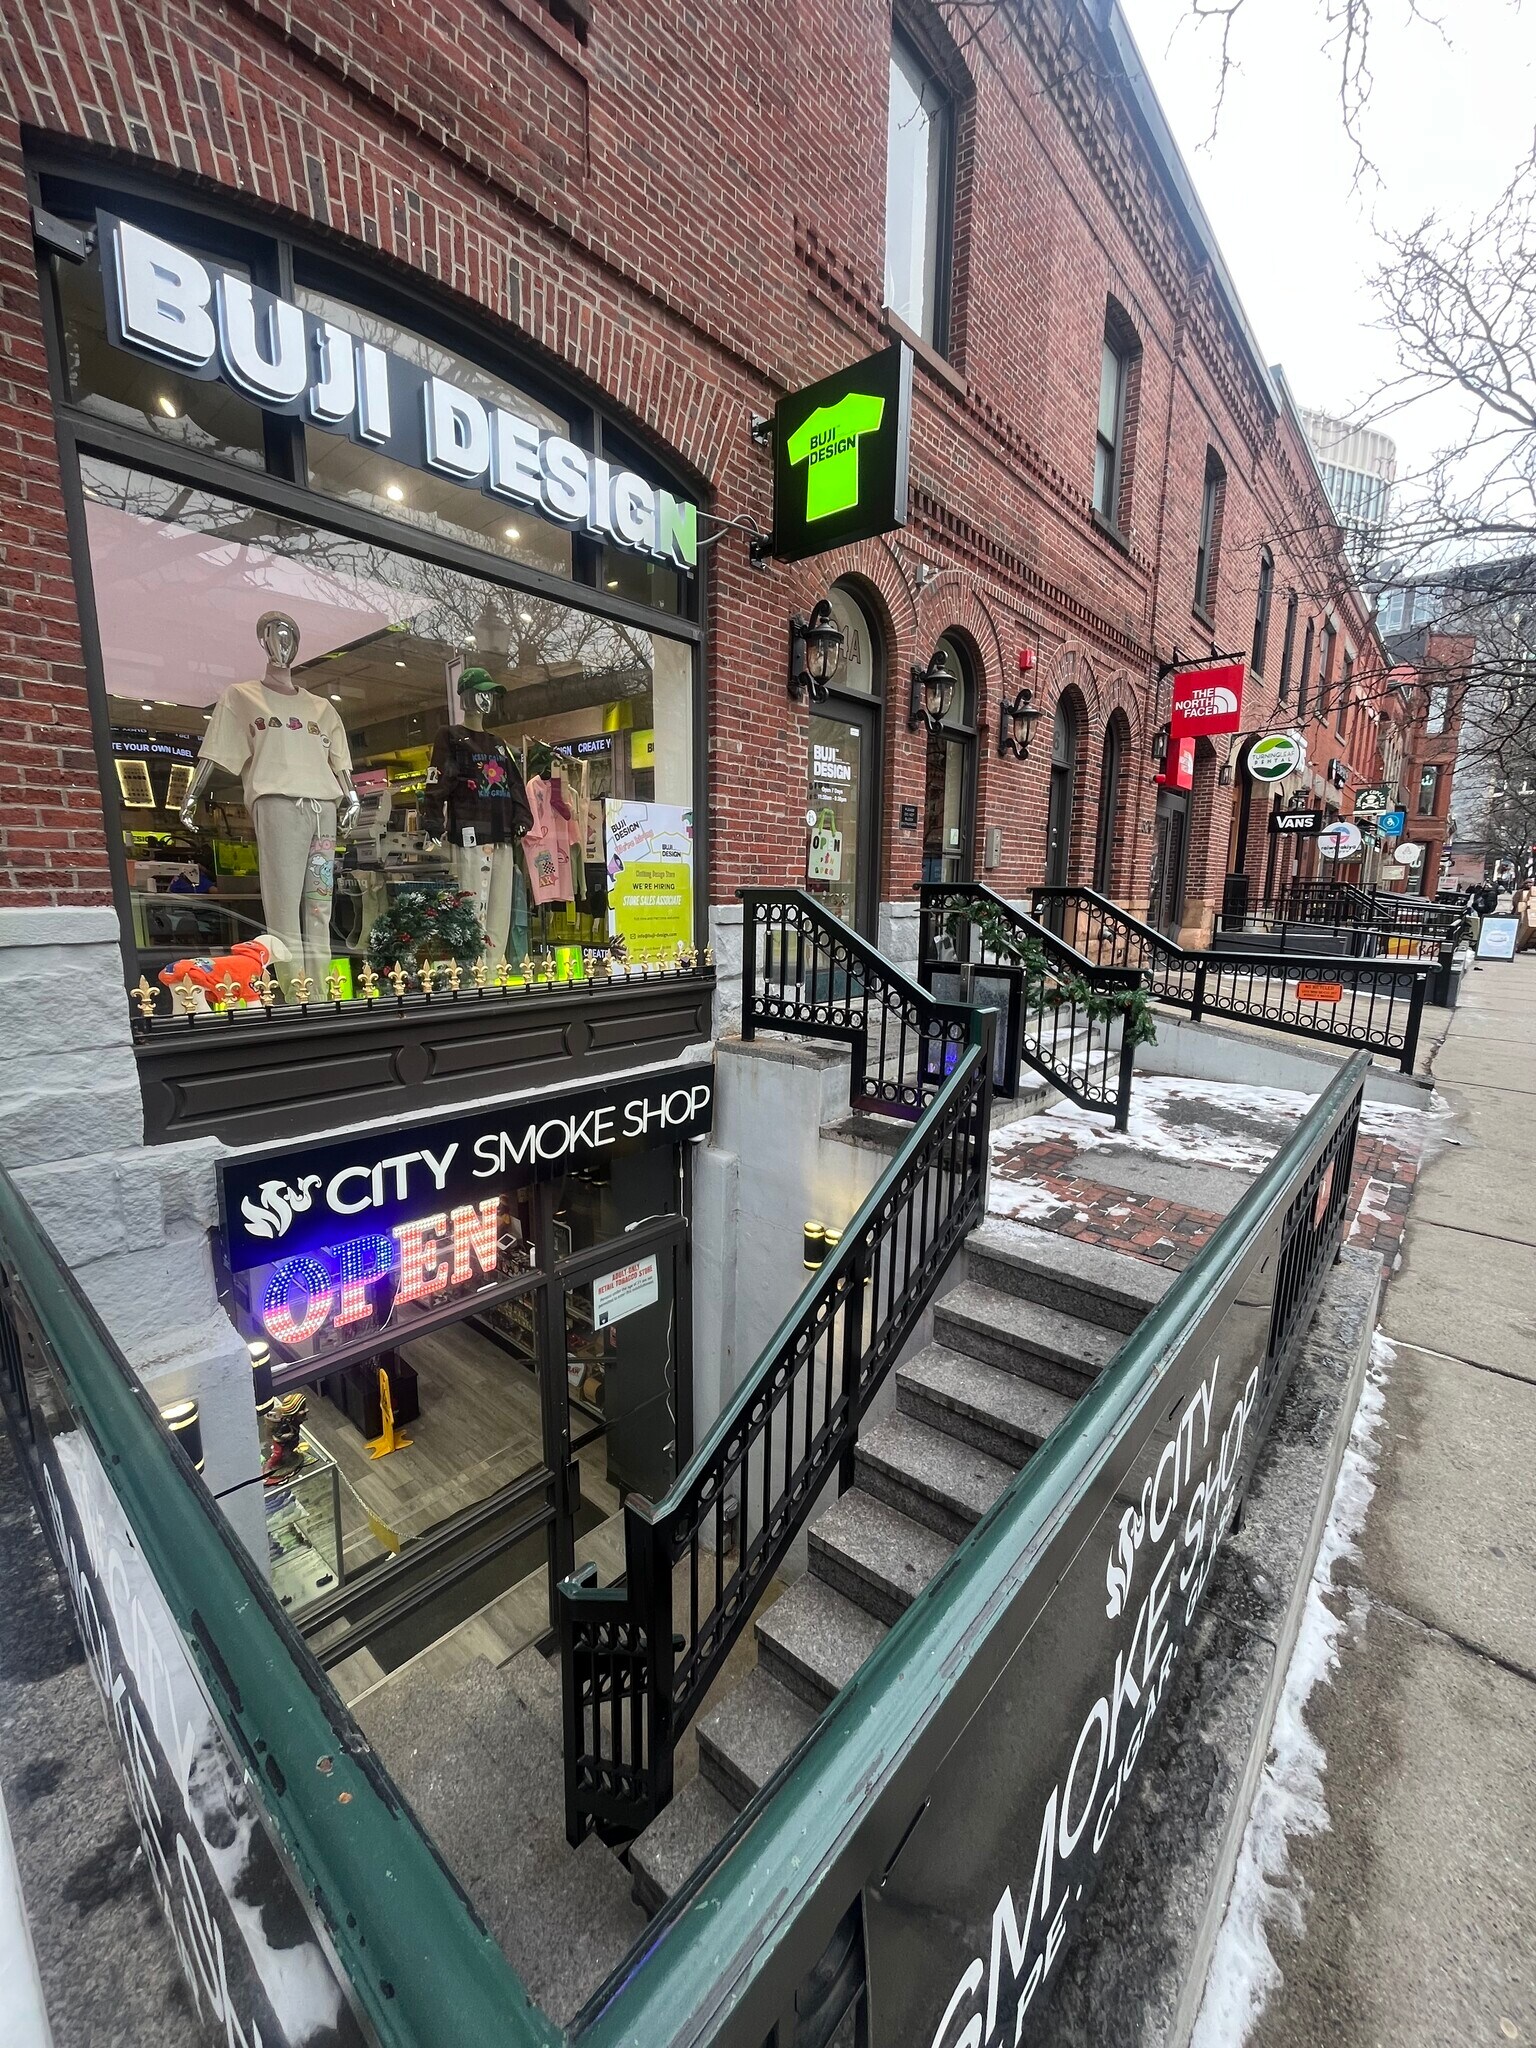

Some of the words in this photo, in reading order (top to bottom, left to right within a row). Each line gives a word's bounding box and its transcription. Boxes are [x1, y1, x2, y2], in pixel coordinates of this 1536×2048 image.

[113, 220, 392, 444] BUJI
[423, 375, 697, 571] DESIGN
[810, 427, 836, 450] BUJI
[810, 434, 856, 466] DESIGN
[1192, 687, 1214, 699] THE
[1175, 697, 1214, 711] NORTH
[1183, 705, 1214, 719] FACE
[123, 742, 150, 752] YOUR
[151, 743, 172, 754] OWN
[172, 748, 194, 758] LABEL
[578, 739, 605, 754] CREATE
[813, 744, 836, 762] BUJI
[1254, 757, 1292, 766] DENTAL
[813, 762, 851, 781] DESIGN
[611, 819, 627, 833] BUJI
[1276, 814, 1315, 829] VANS
[614, 821, 640, 842] DESIGN
[661, 850, 682, 858] DESIGN
[632, 882, 653, 890] WE'RE
[622, 895, 640, 906] STORE
[640, 895, 656, 906] SALES
[656, 895, 682, 906] ASSOCIATE
[326, 1142, 459, 1215] CITY
[472, 1106, 616, 1178] SMOKE
[622, 1084, 711, 1137] SHOP
[263, 1196, 500, 1344] OPEN
[598, 1283, 615, 1295] RETAIL
[615, 1272, 638, 1287] TOBACCO
[639, 1264, 653, 1277] STORE
[1150, 1355, 1219, 1543] CITY
[1180, 1366, 1258, 1591] SHOP
[1093, 1642, 1174, 1854] CIGAR
